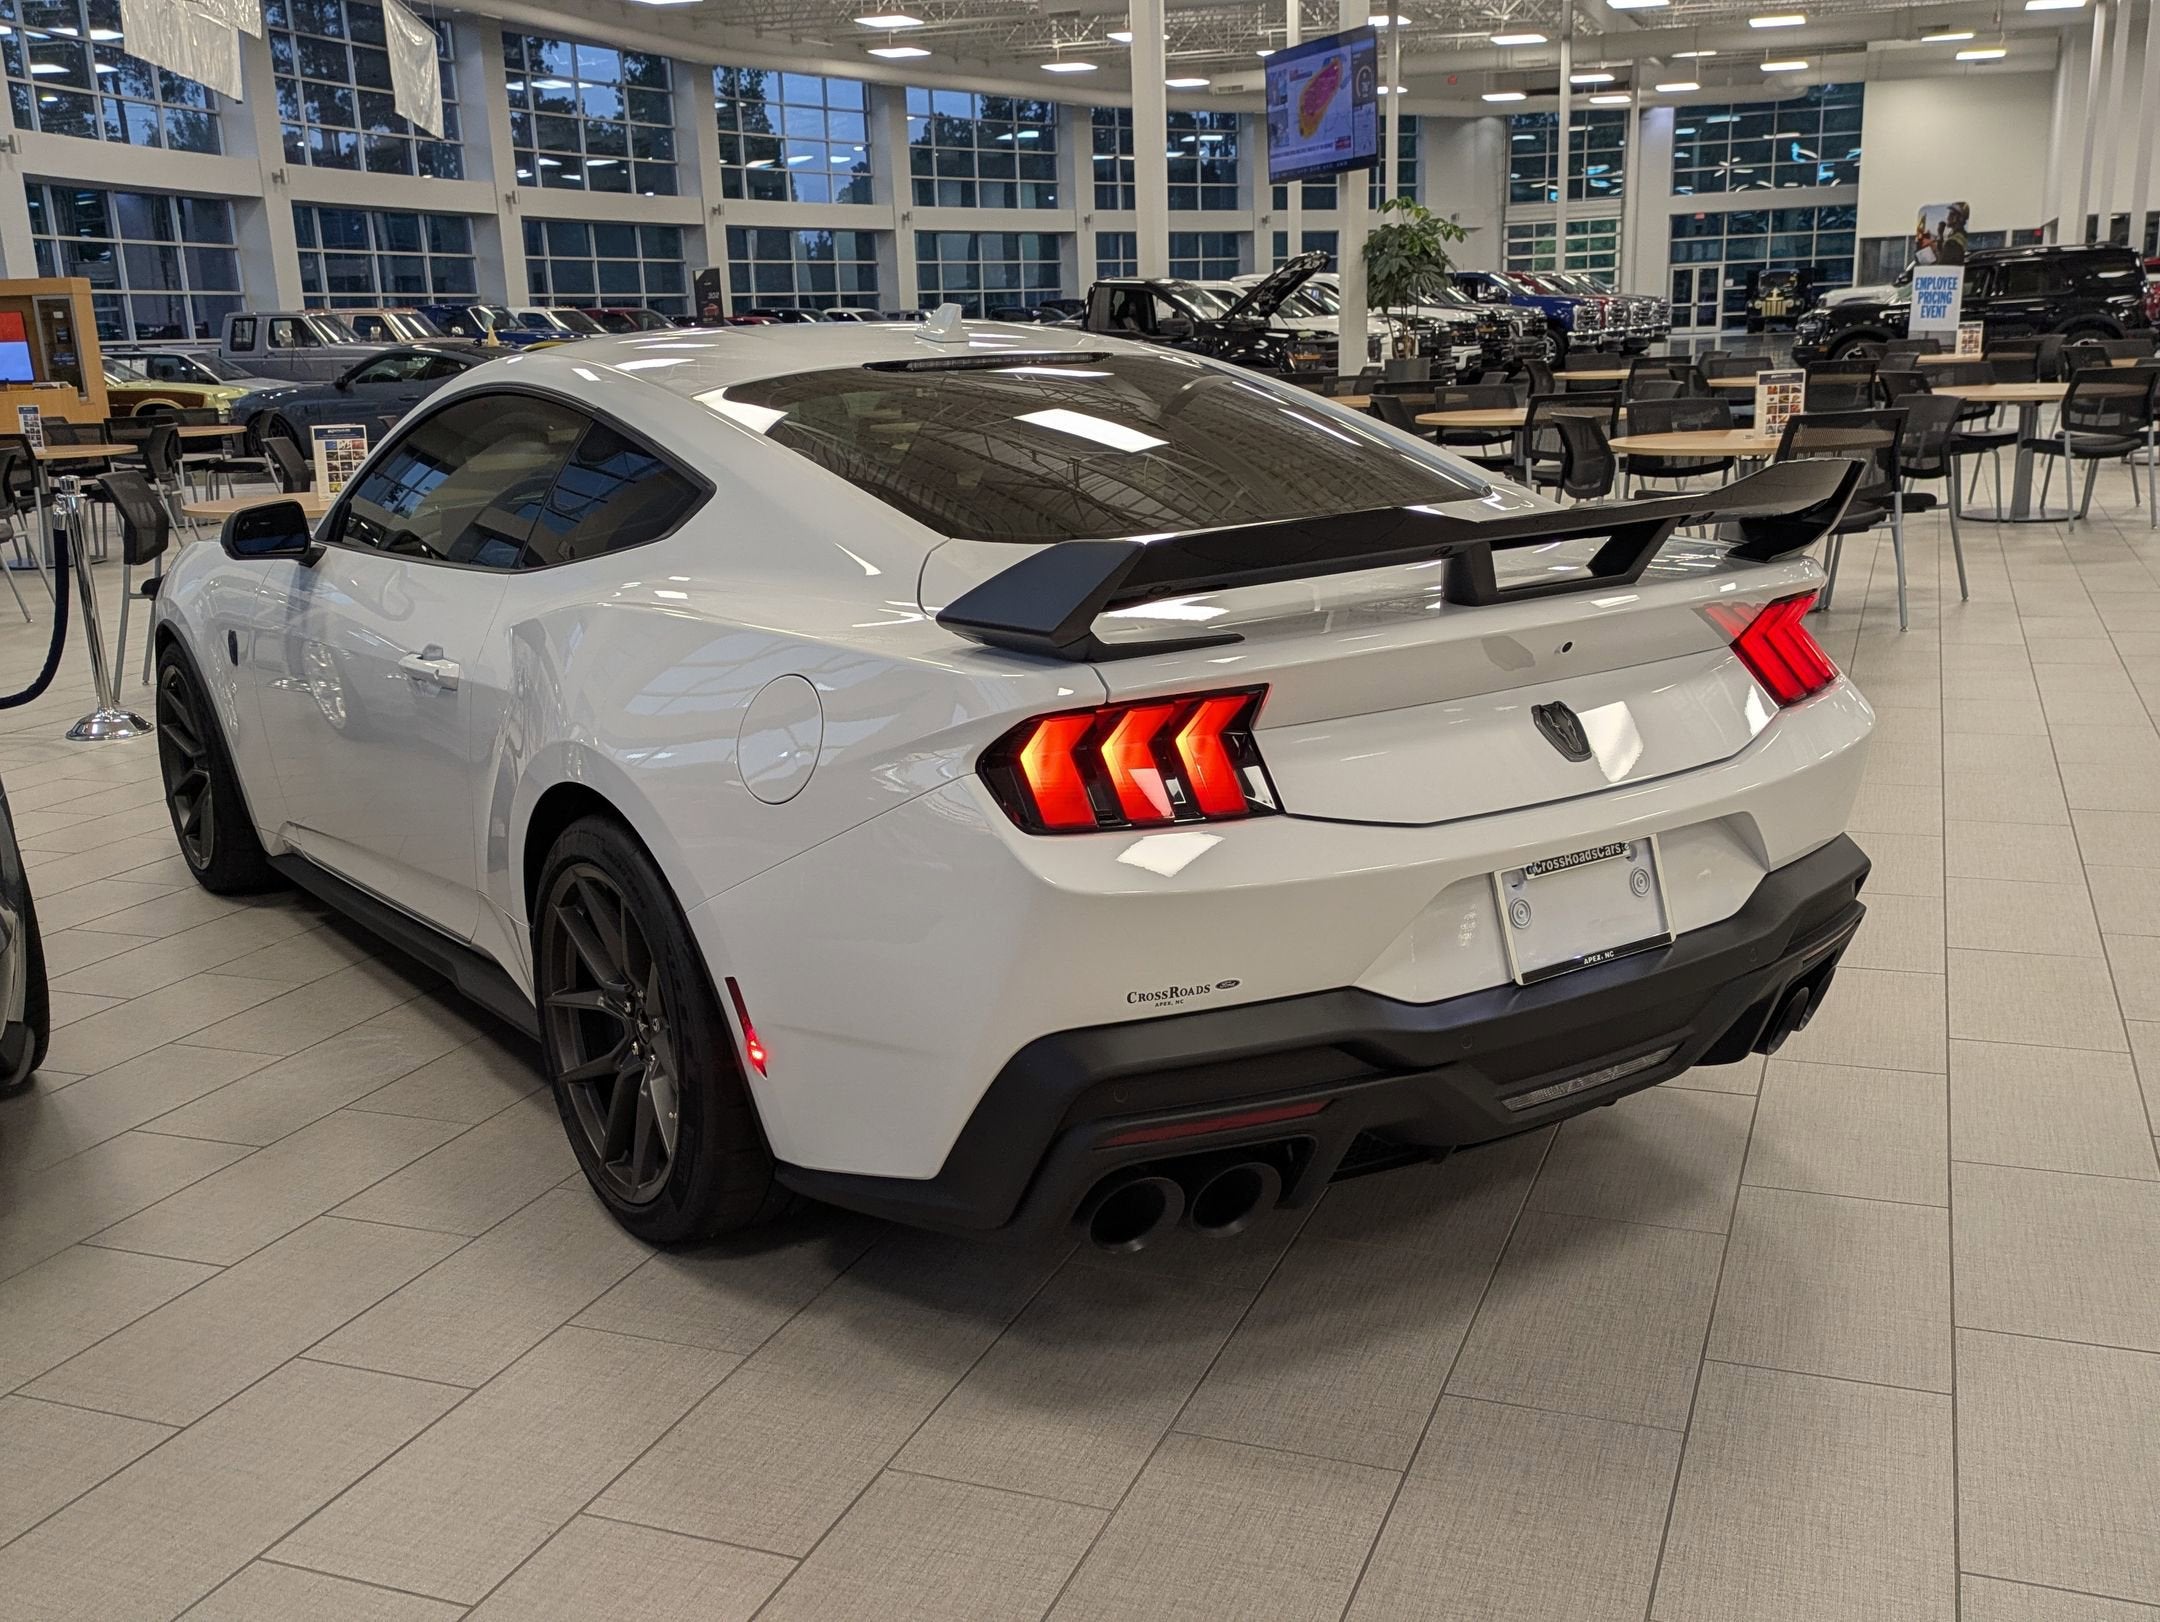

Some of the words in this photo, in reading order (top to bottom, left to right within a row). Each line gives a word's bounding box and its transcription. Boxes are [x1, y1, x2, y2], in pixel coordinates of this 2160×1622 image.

[1915, 277, 1958, 291] EMPLOYEE
[1918, 291, 1952, 305] PRICING
[1920, 305, 1947, 319] EVENT
[1534, 843, 1621, 874] CrossRoadsCars
[1605, 951, 1614, 959] NC
